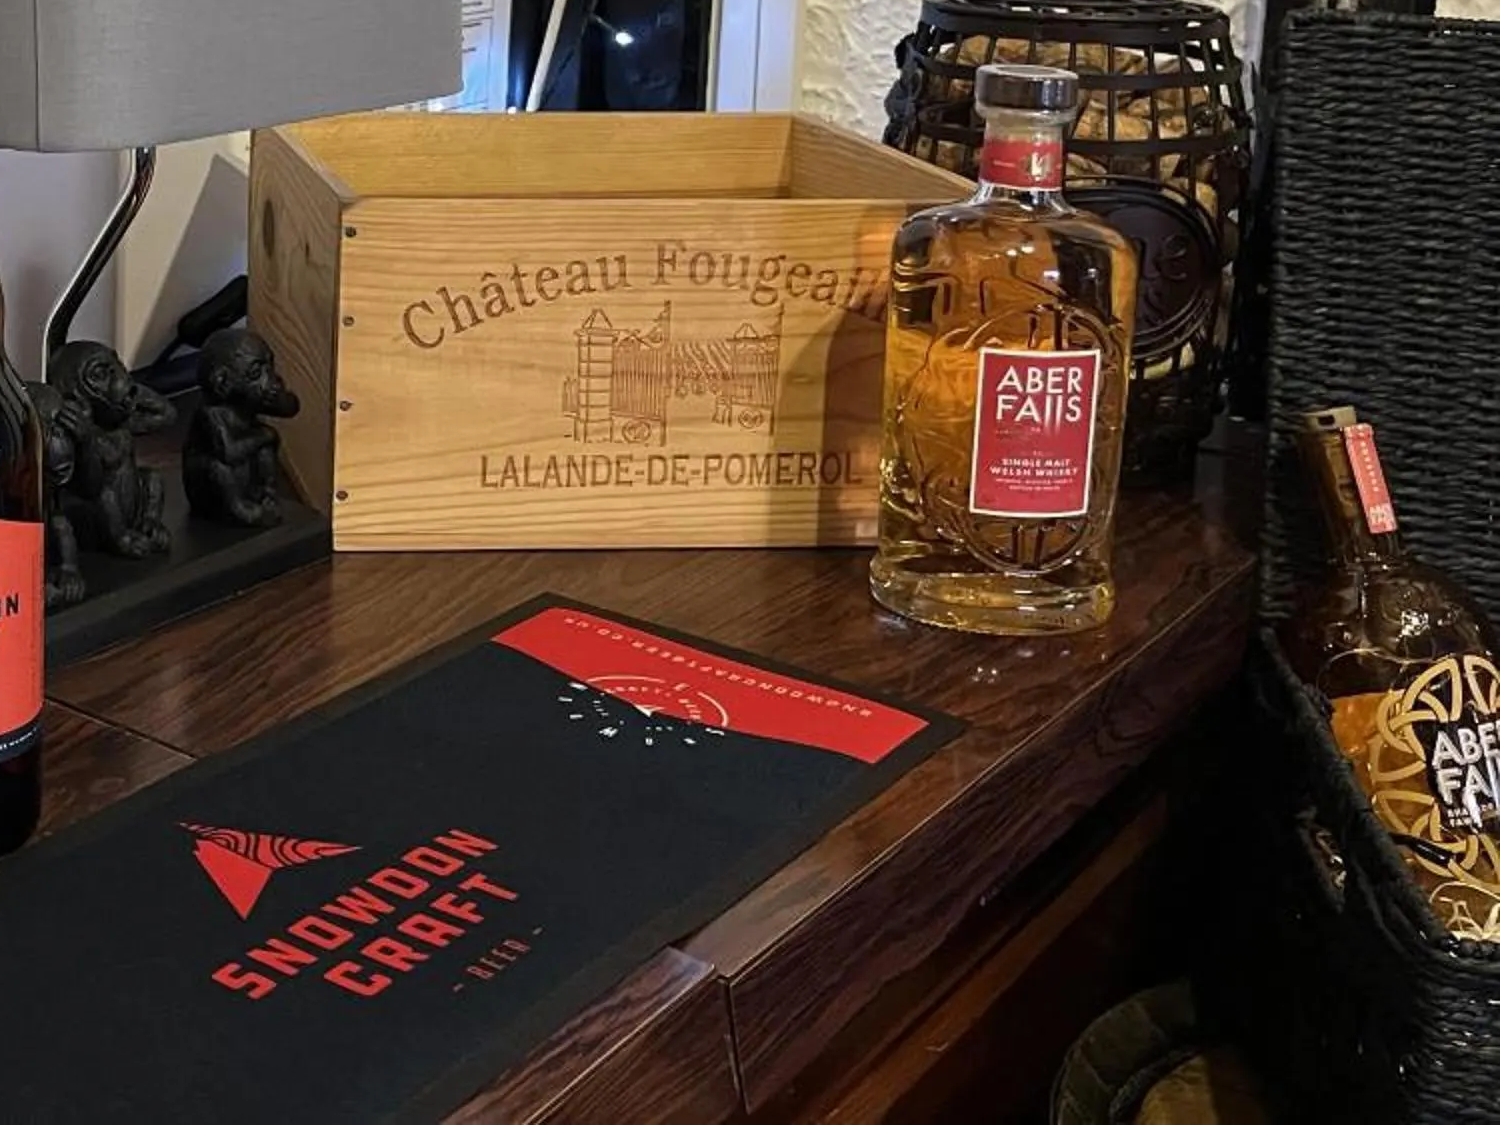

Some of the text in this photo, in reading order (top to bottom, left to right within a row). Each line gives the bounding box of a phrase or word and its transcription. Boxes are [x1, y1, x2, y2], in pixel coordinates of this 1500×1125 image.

[402, 249, 632, 350] Château
[996, 365, 1082, 394] ABER
[480, 451, 863, 489] LALANDE-DE-POMEROL
[990, 466, 1031, 476] WELSH
[212, 828, 499, 1000] SNOWDON
[323, 872, 519, 996] CRAFT
[467, 939, 531, 980] BEER
